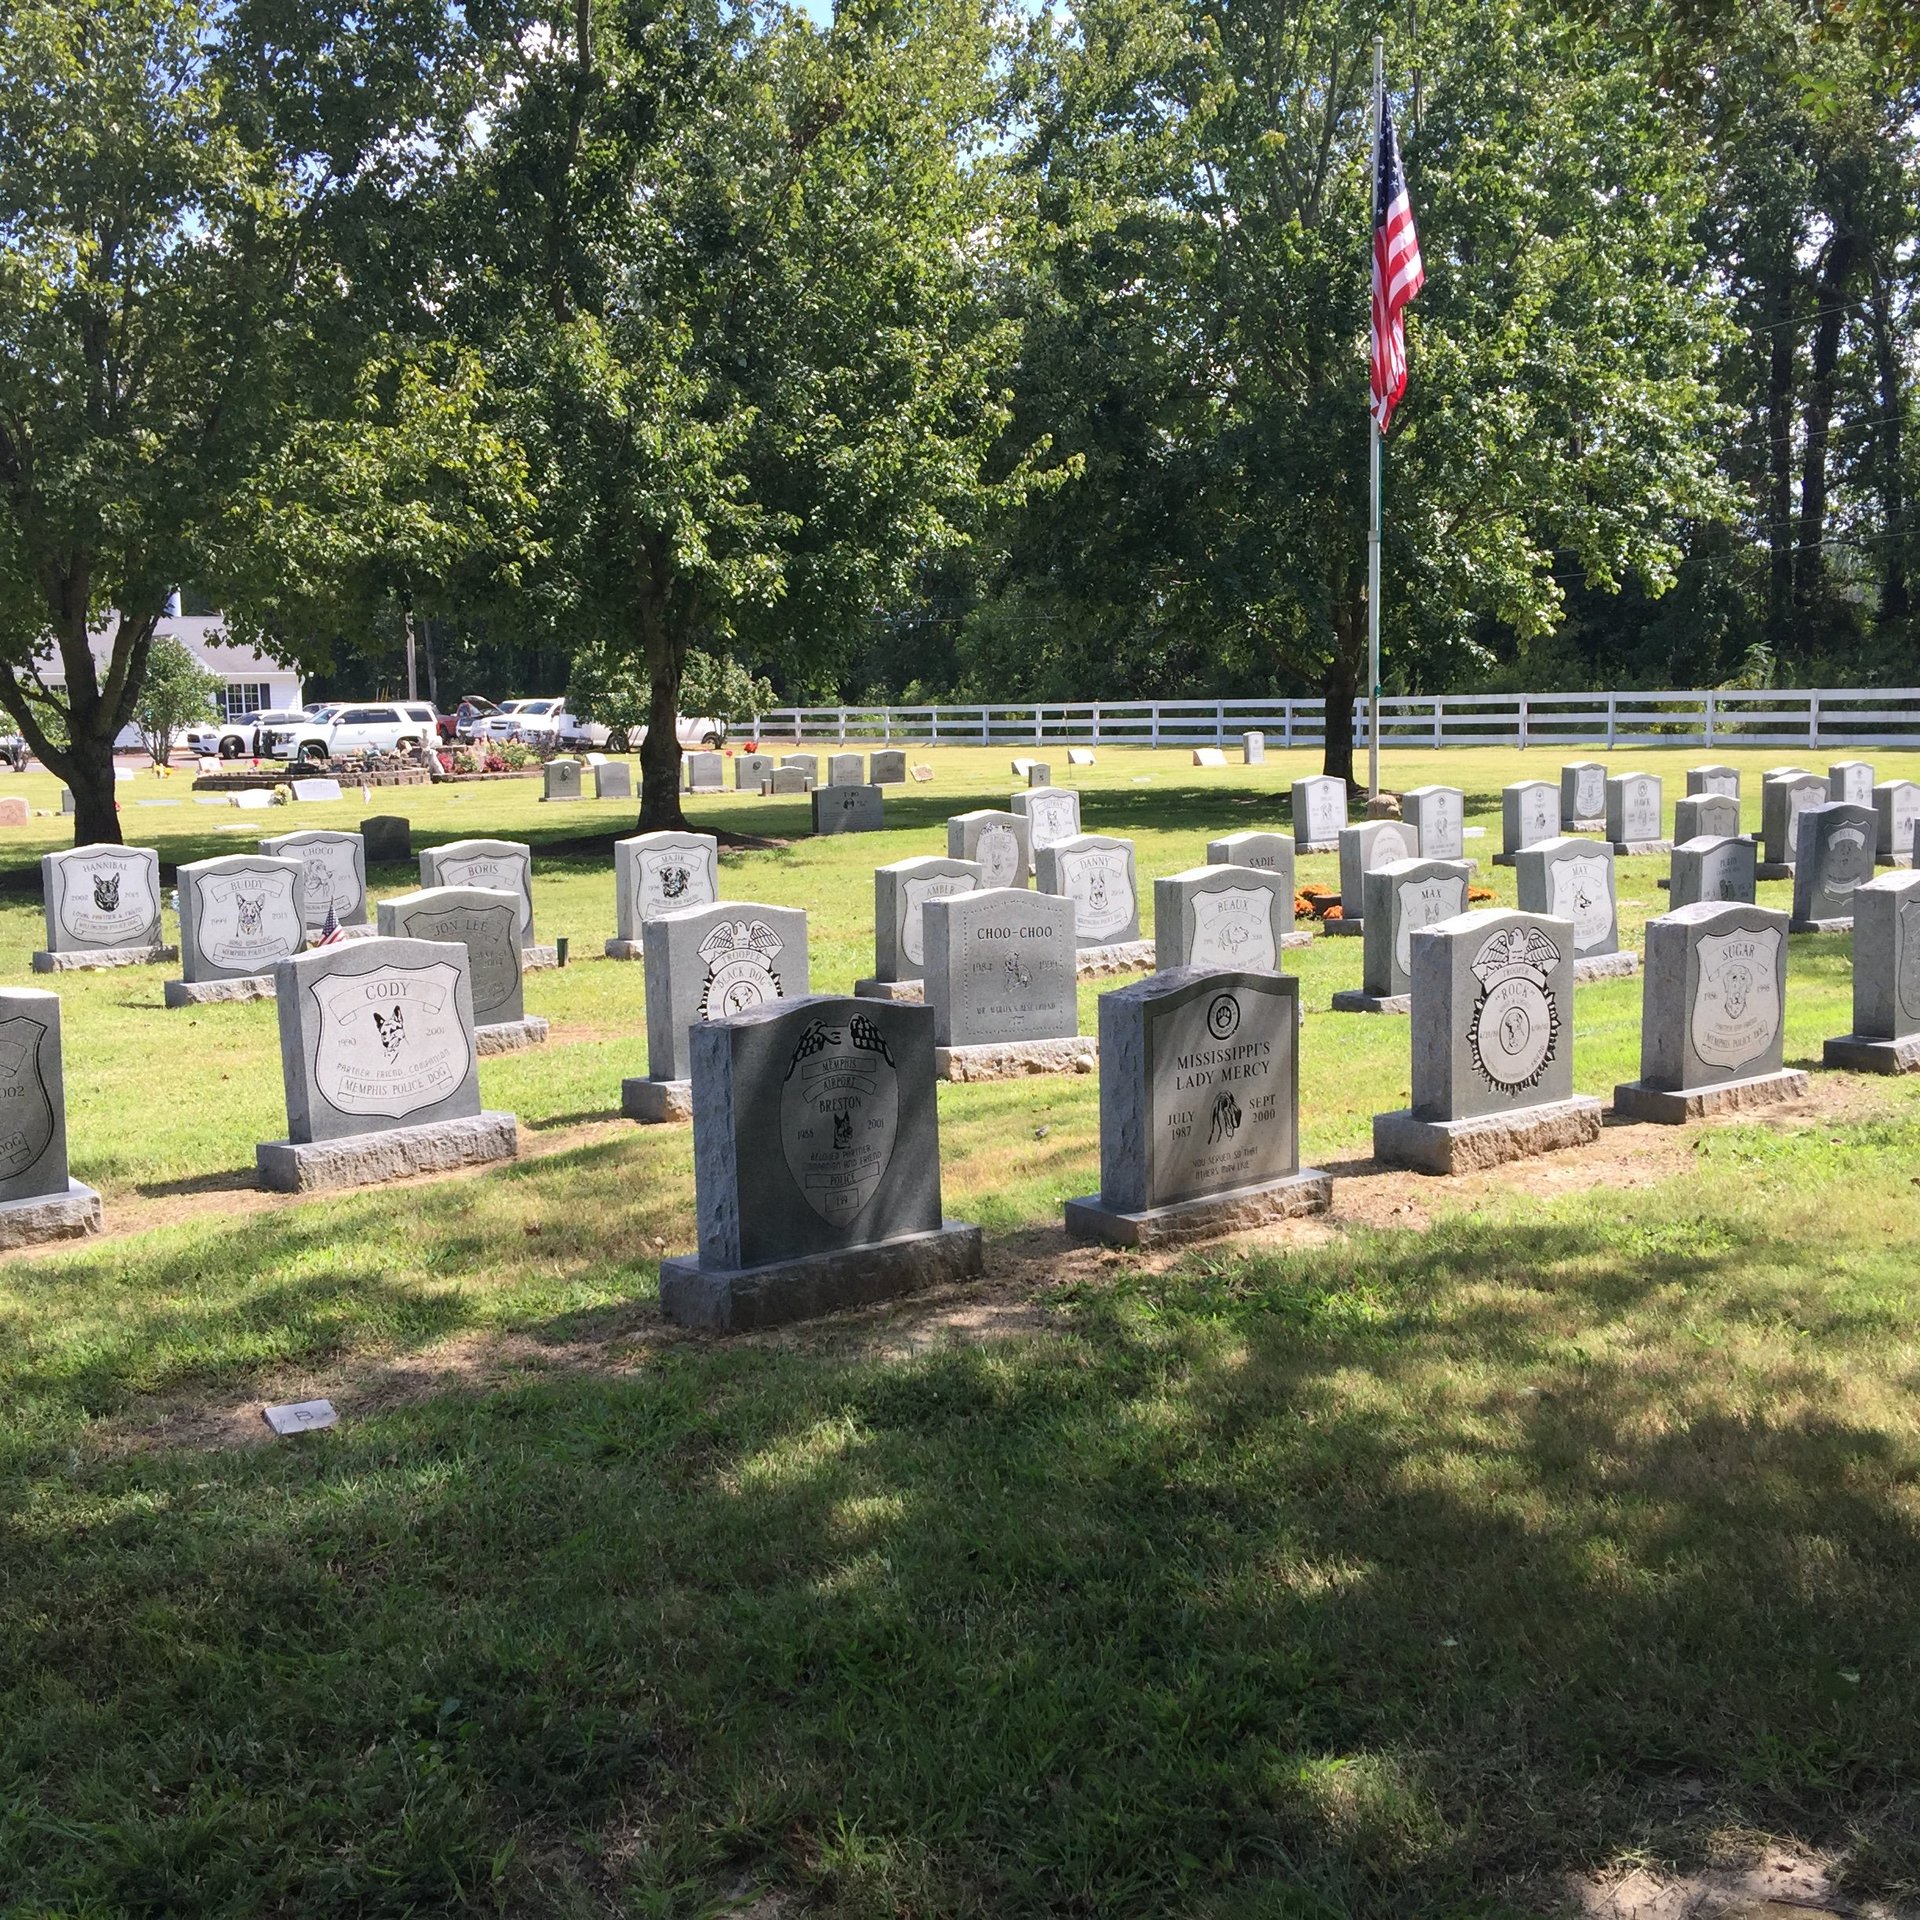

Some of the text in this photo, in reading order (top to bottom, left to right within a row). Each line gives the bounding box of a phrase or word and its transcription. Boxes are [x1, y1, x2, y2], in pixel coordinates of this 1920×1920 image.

[302, 847, 334, 857] CHOCO
[82, 861, 128, 873] HANNIBAL
[1080, 856, 1111, 869] DANNY
[1249, 856, 1275, 868] SADIE
[468, 864, 499, 876] BORIS
[1572, 865, 1588, 875] MAX
[230, 880, 265, 890] BUDDY
[926, 886, 954, 896] AMBER
[1421, 889, 1442, 899] MAX
[1217, 900, 1249, 913] BEAUX
[434, 919, 488, 937] JON LEE
[977, 926, 1053, 939] CHOO-CHOO
[722, 951, 761, 963] TROOPER
[1722, 944, 1755, 960] SUGAR
[1503, 967, 1529, 978] TROOPER
[365, 982, 411, 1000] CODY
[425, 1027, 445, 1036] 2001
[337, 1038, 357, 1047] 1990
[409, 1048, 450, 1073] COMPANION
[1177, 1041, 1271, 1070] MISSISSIPPI'S
[822, 1059, 857, 1072] MEMPHIS
[344, 1067, 447, 1096] MEMPHIS POLICE DOG
[1176, 1061, 1270, 1091] LADY MERCY
[823, 1077, 856, 1090] AIRPORT
[820, 1096, 862, 1114] BRESTON
[1249, 1094, 1276, 1110] SEPT
[1167, 1111, 1195, 1126] JULY
[1252, 1109, 1276, 1123] 2000
[867, 1118, 885, 1130] 2001
[1171, 1126, 1192, 1141] 1987
[842, 1144, 872, 1159] PARTNER
[830, 1173, 857, 1187] POLICE
